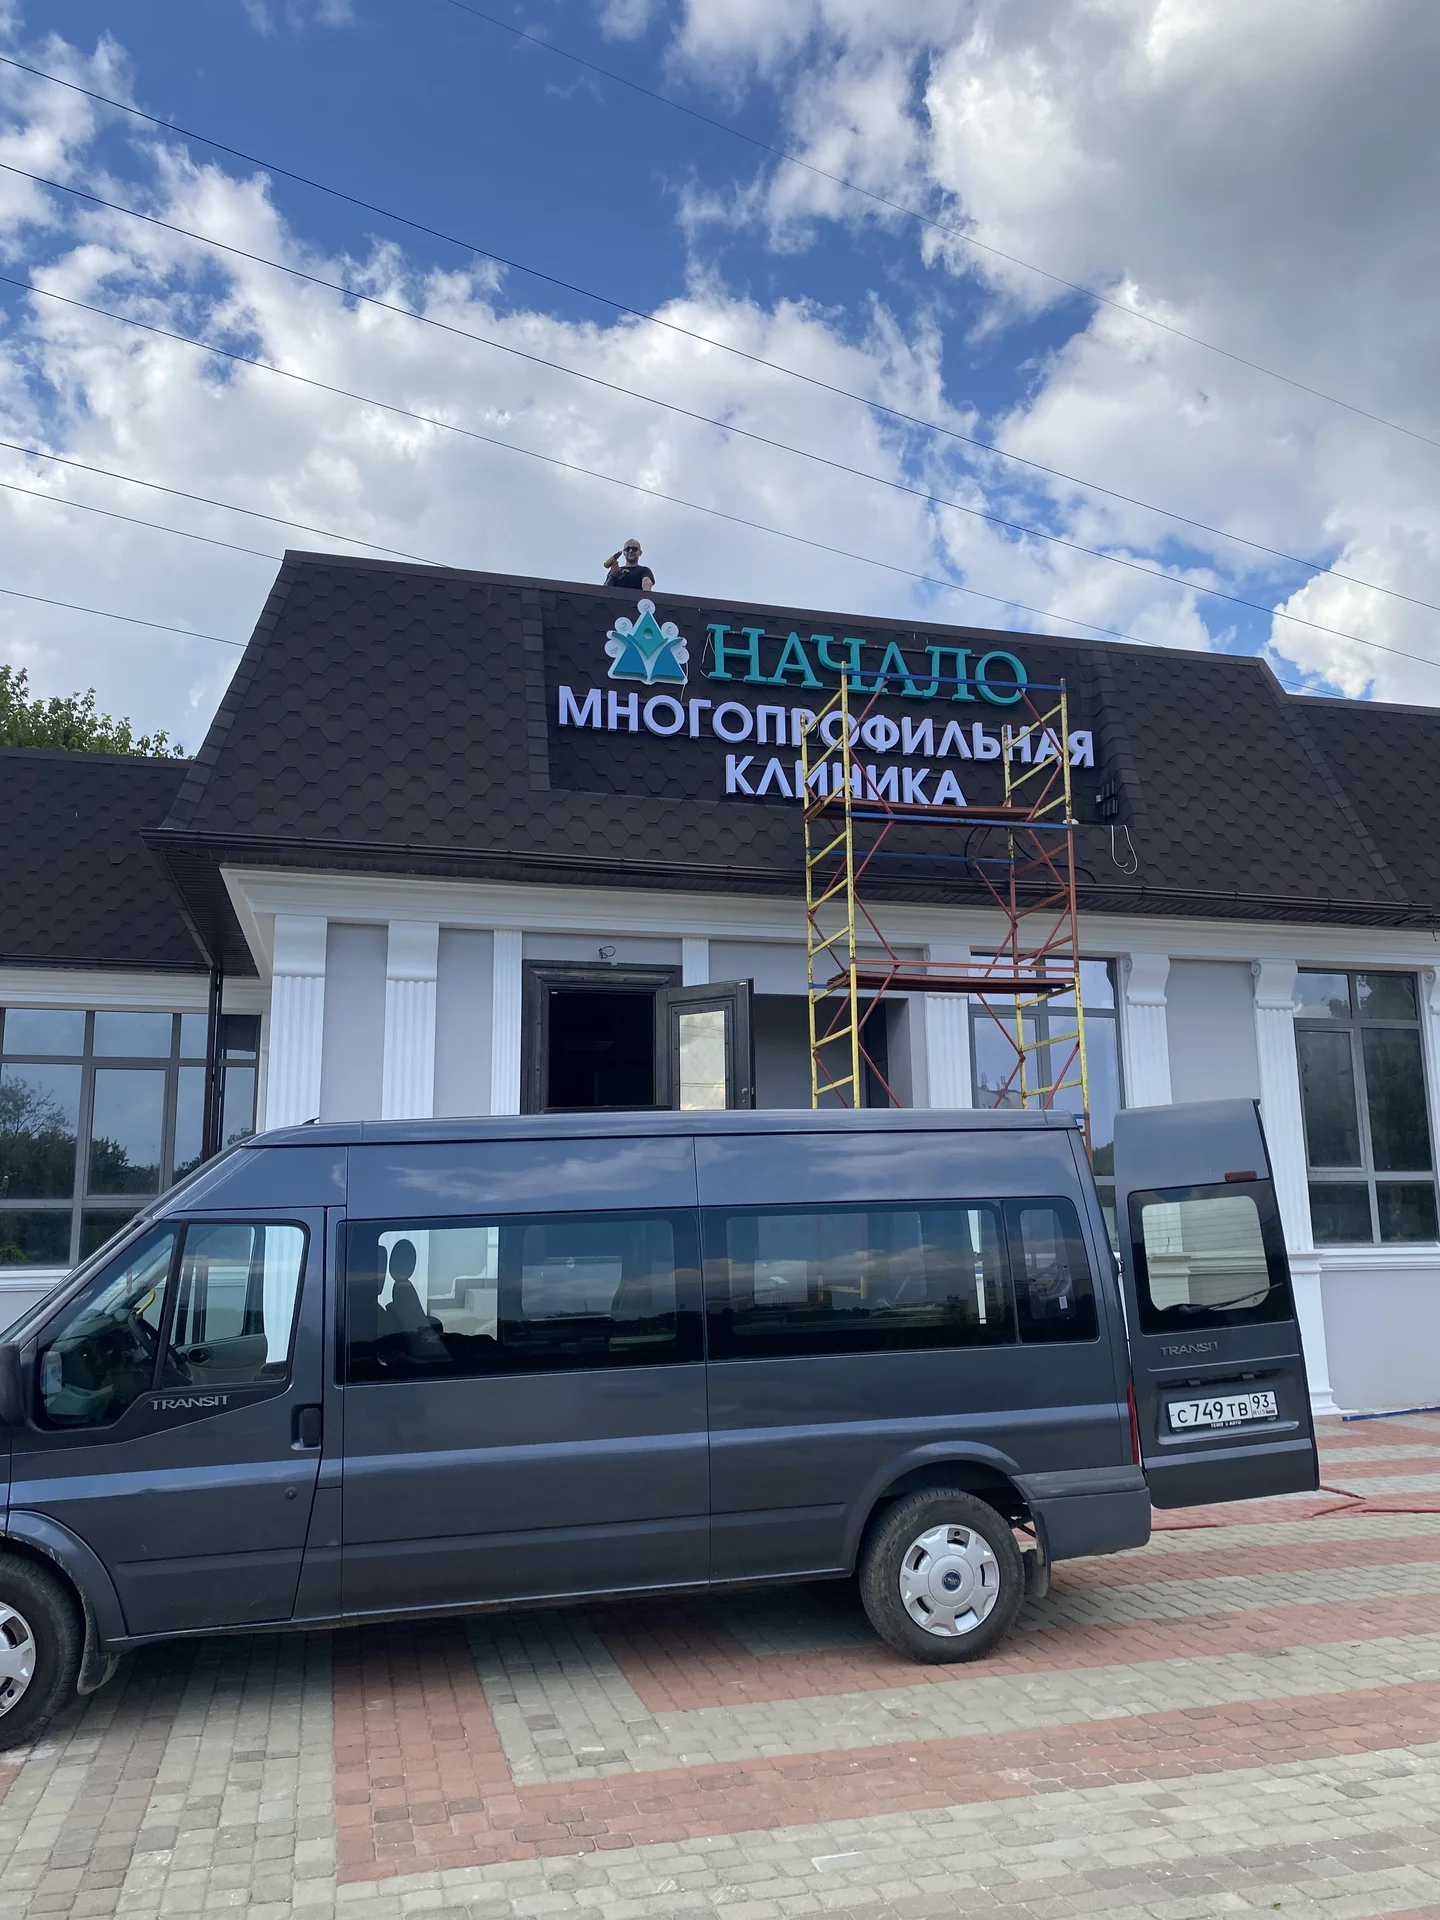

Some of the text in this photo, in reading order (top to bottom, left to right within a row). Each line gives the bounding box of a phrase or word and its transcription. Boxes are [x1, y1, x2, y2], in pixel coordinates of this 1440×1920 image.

[706, 623, 1028, 706] НАЧАЛО
[558, 685, 1094, 768] МНОГОПРОФИЛЬНАЯ
[725, 754, 967, 807] КЛИНИКА
[1160, 1342, 1218, 1356] TRANSIT
[151, 1395, 230, 1410] TRANSIT
[1252, 1394, 1270, 1409] 93
